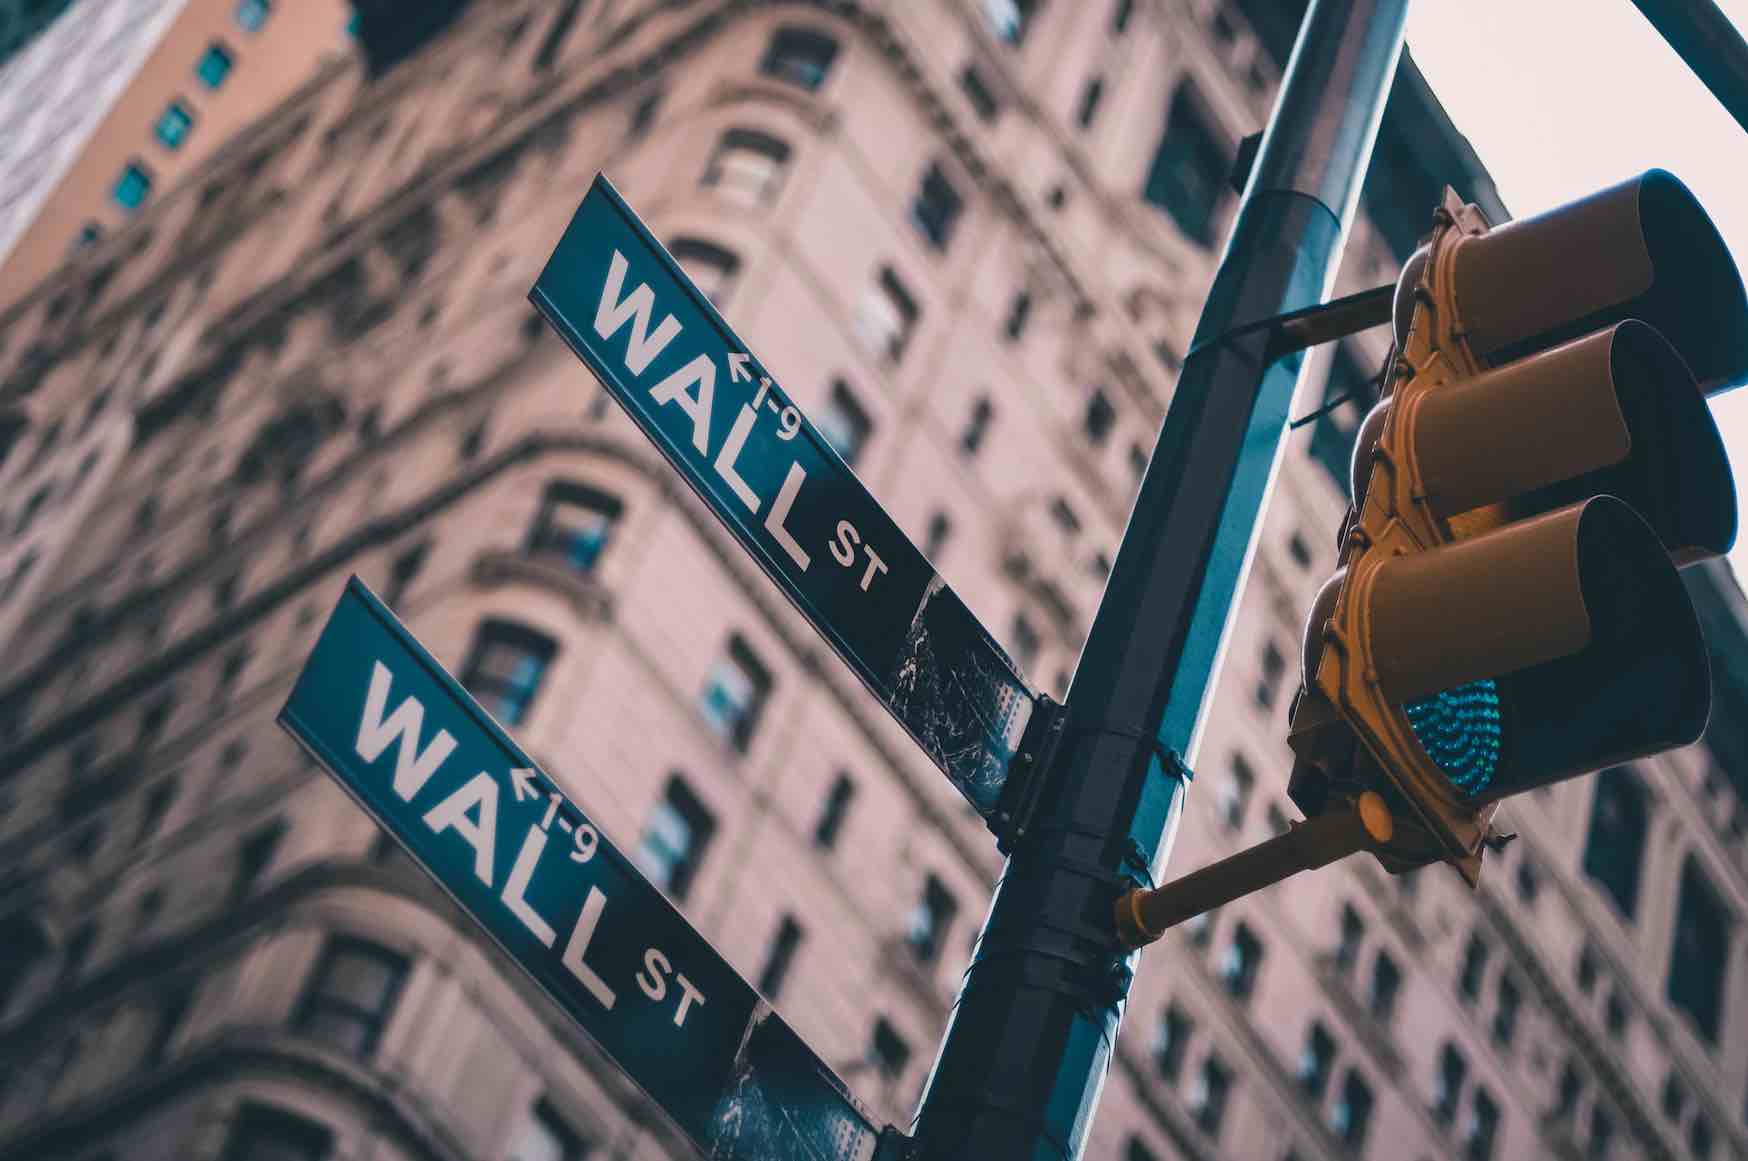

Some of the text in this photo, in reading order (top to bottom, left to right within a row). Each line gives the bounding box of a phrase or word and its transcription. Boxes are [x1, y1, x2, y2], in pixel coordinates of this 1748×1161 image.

[593, 248, 889, 592] WALL ST
[754, 376, 802, 441] 1-9
[354, 659, 706, 1028] WALL ST
[540, 793, 599, 864] 1-9
